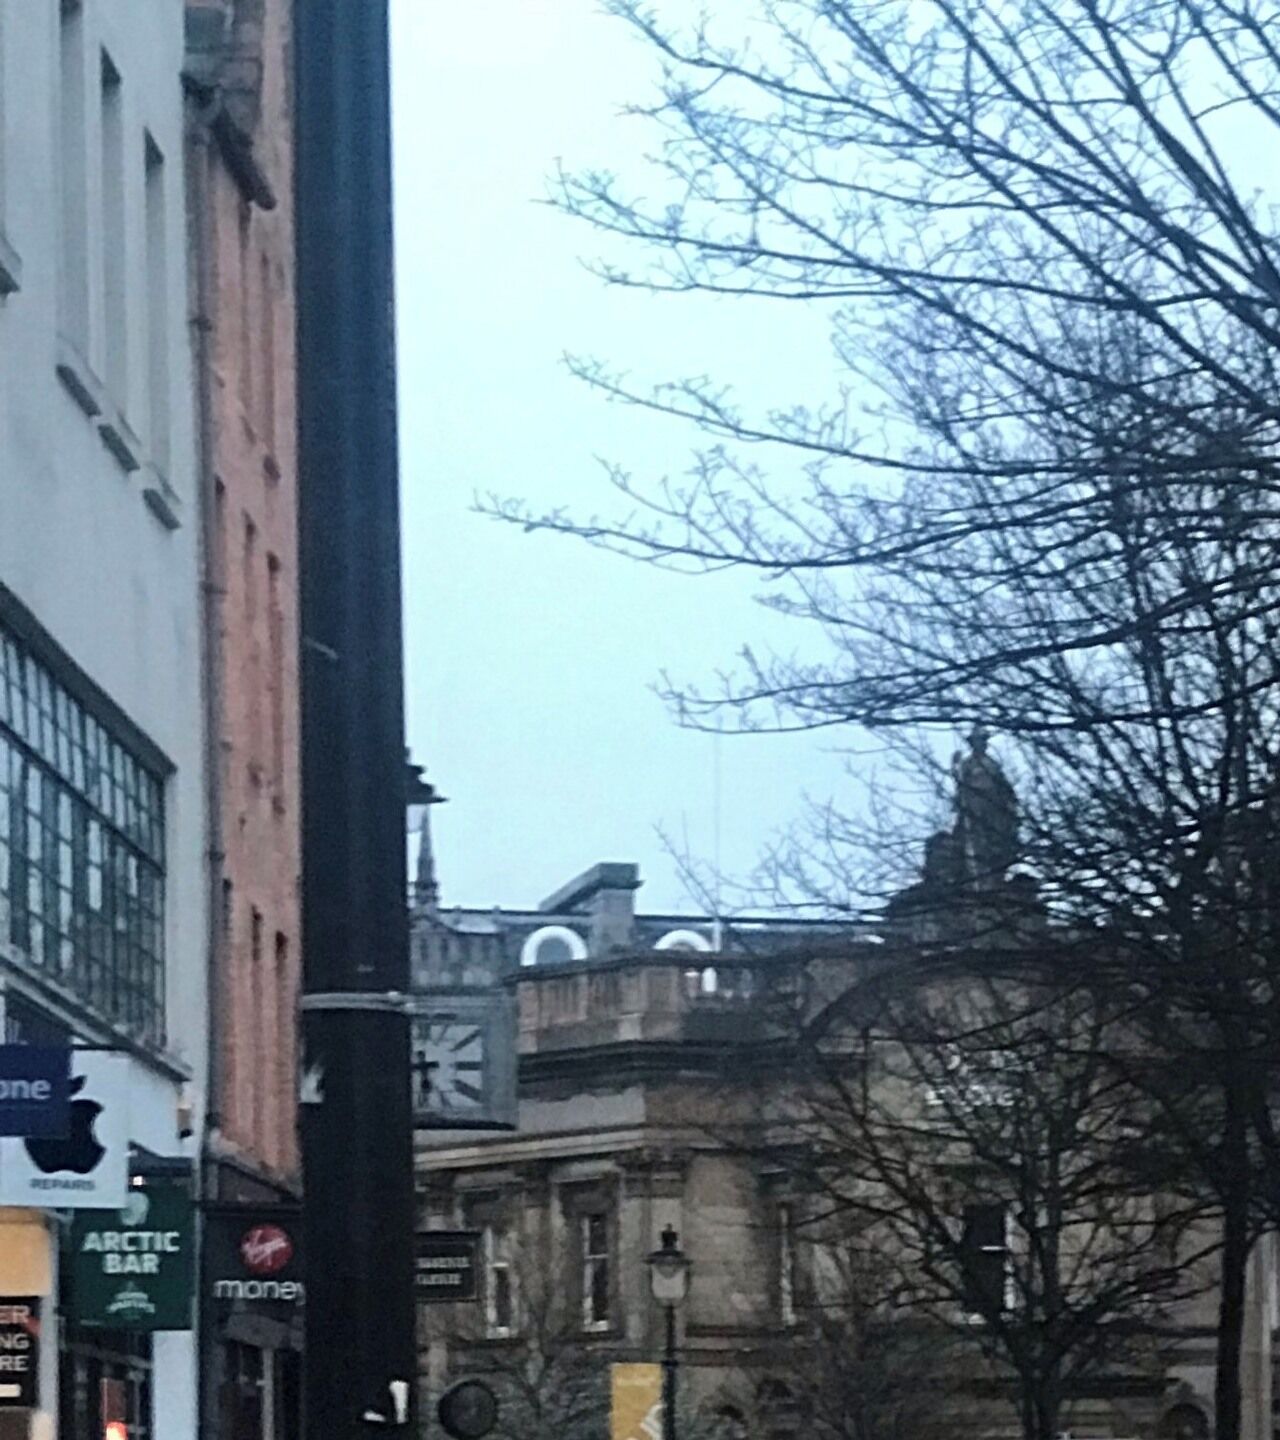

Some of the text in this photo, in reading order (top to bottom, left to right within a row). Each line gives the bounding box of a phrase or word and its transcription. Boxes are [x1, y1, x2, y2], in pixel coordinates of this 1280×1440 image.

[29, 1178, 96, 1192] REPAIRS
[82, 1231, 181, 1252] ARCTIC
[103, 1253, 160, 1274] BAR
